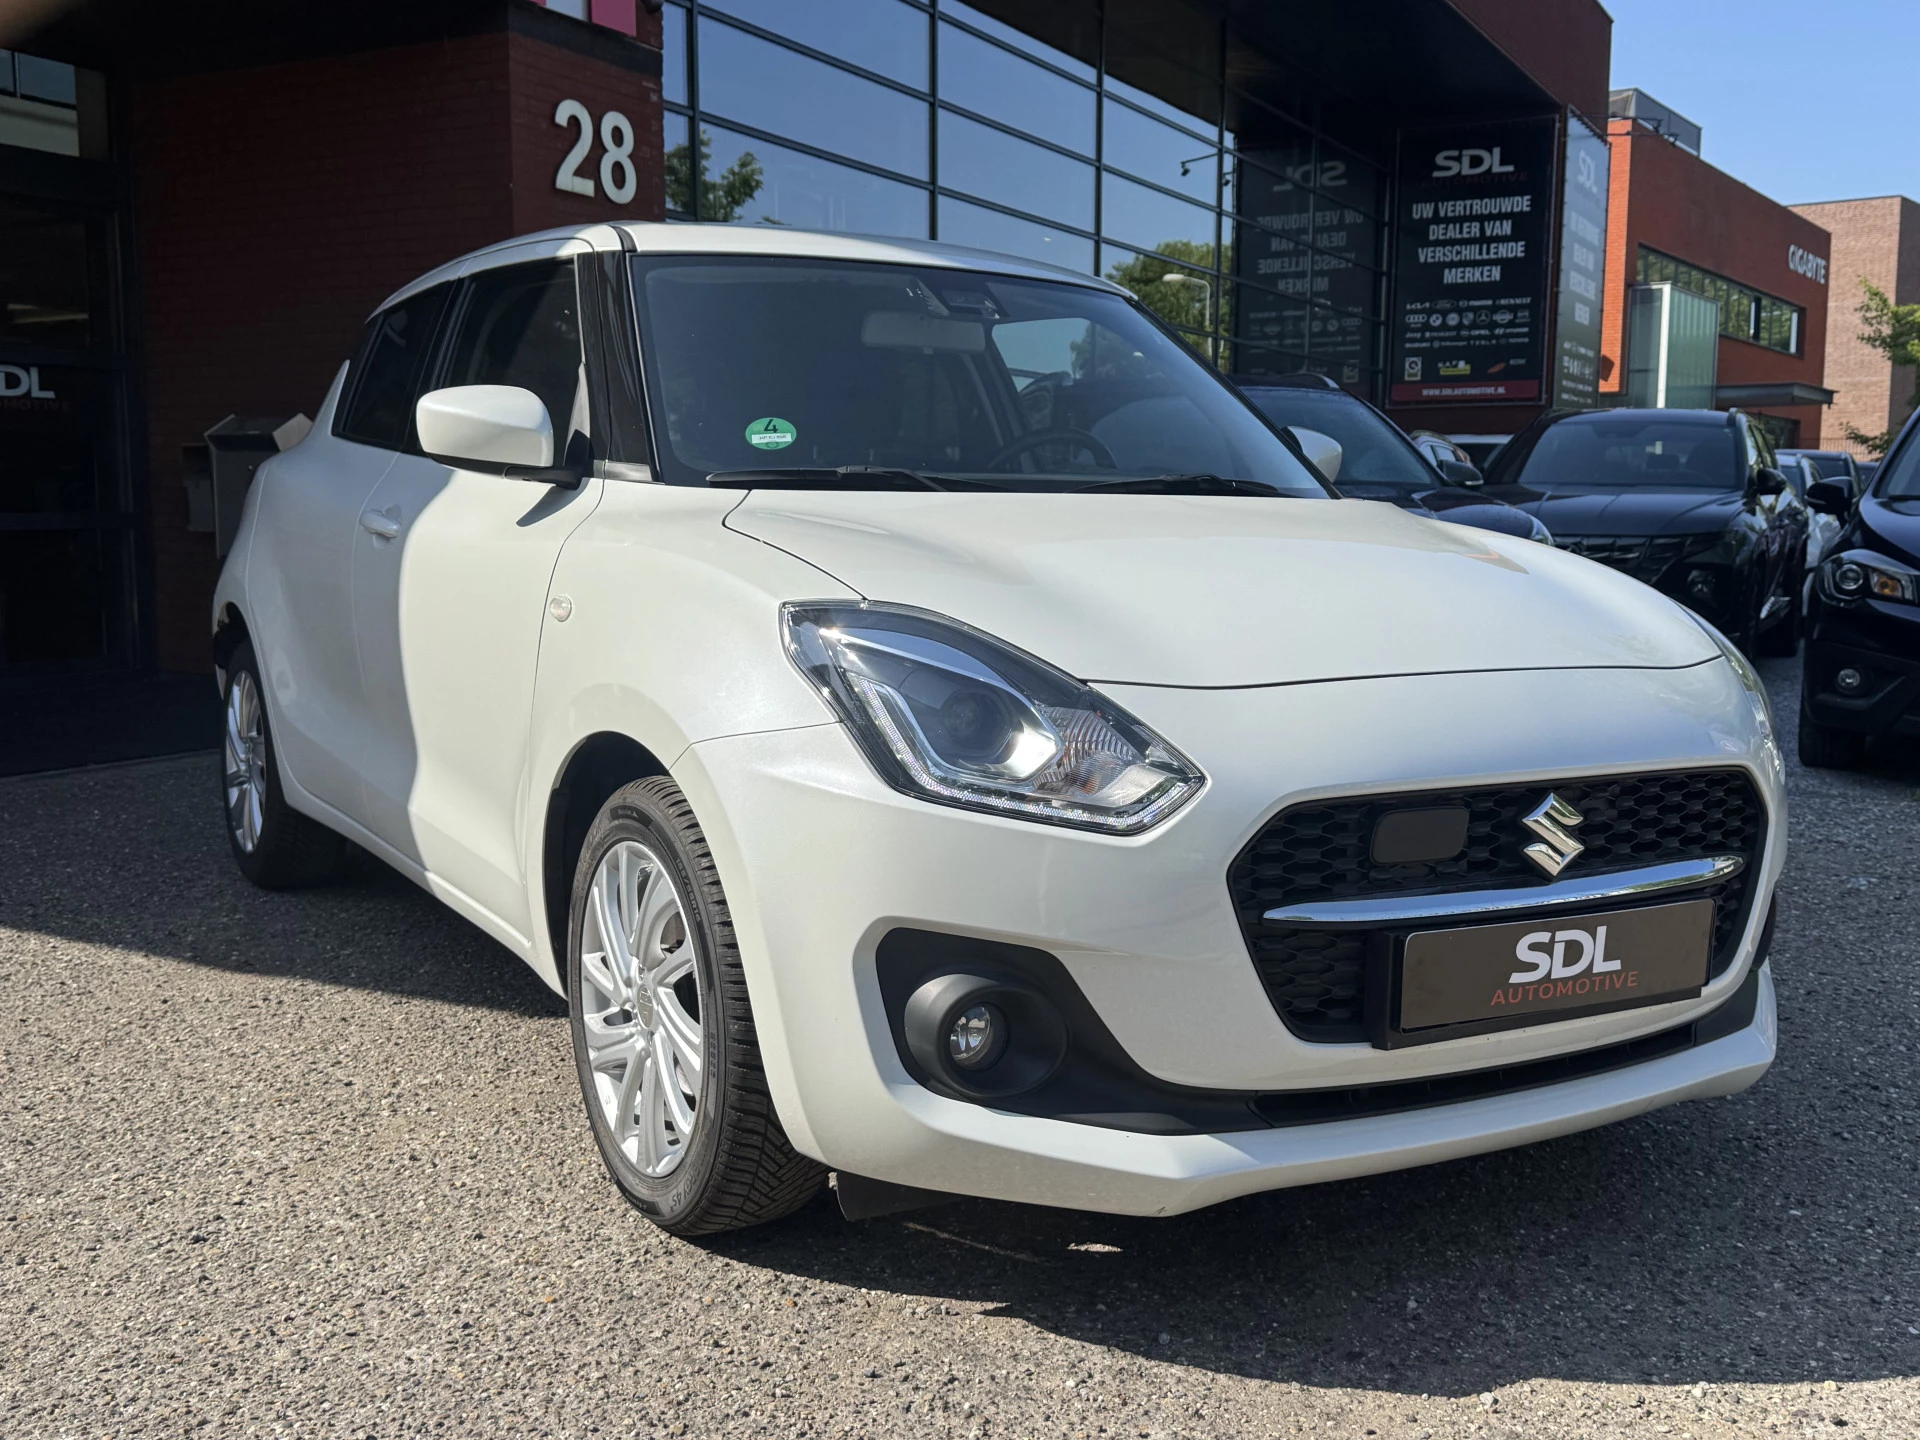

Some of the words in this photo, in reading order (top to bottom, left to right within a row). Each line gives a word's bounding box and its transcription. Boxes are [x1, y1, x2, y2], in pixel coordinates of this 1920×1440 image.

[555, 99, 637, 204] 28
[1432, 146, 1515, 177] SDL
[1412, 202, 1435, 219] UW
[1438, 195, 1532, 218] VERTROUWDE
[1429, 221, 1480, 241] DEALER
[1484, 218, 1513, 238] VAN
[1418, 241, 1526, 264] VERSCHILLENDE
[1787, 244, 1826, 285] GIGABYTE
[1443, 265, 1502, 284] MERKEN
[0, 364, 56, 399] DL
[764, 418, 779, 433] 4
[1509, 926, 1622, 983] SDL
[1491, 971, 1639, 1006] AUTOMOTIVE
